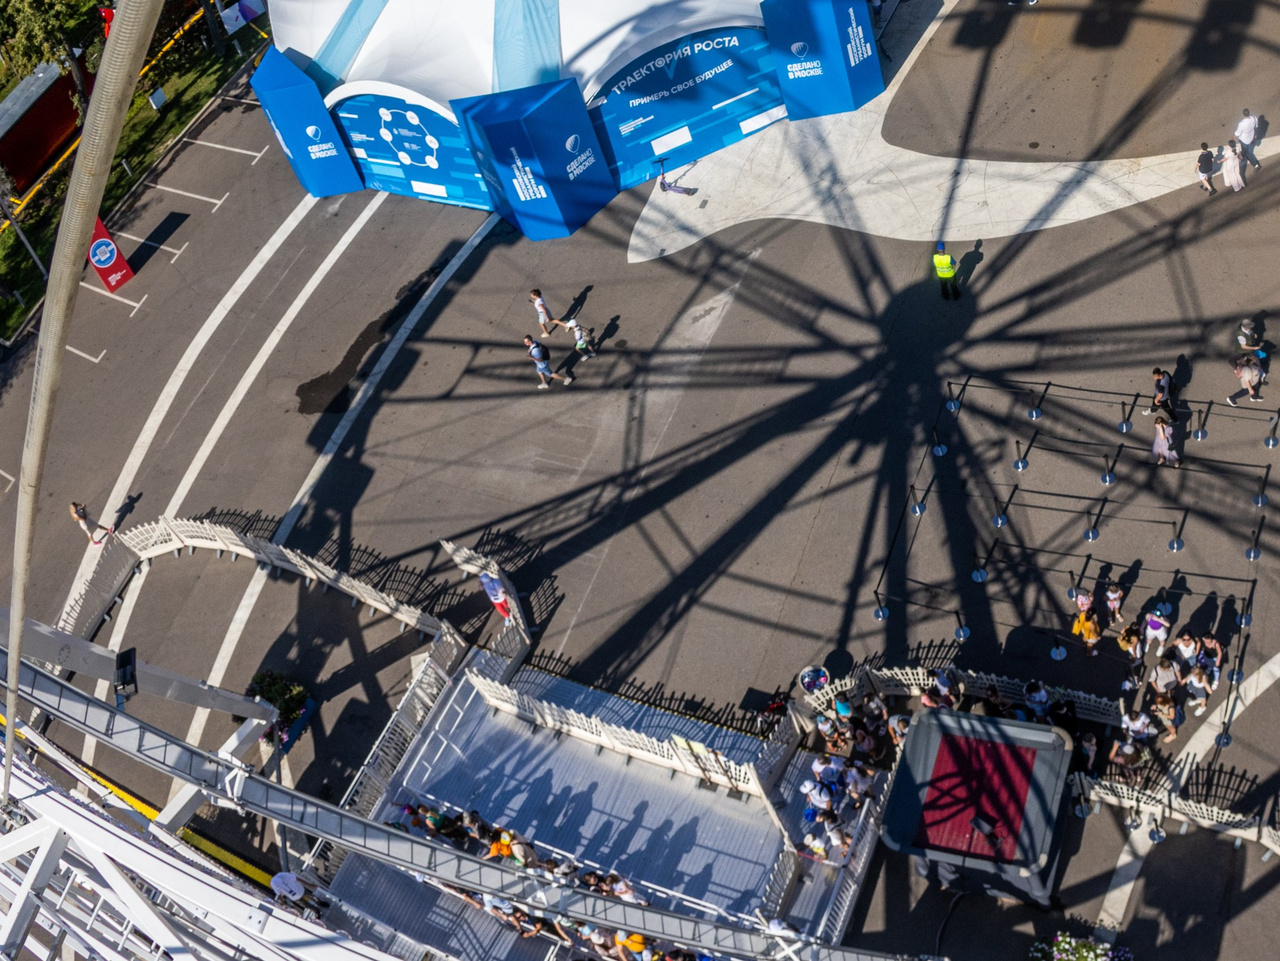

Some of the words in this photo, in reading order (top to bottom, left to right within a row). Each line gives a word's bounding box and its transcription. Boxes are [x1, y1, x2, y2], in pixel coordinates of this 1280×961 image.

[611, 46, 692, 95] ТРАЕКТОРИЯ
[694, 36, 739, 54] РОСТА
[787, 60, 821, 72] СДЕЛАНО
[794, 68, 823, 78] МОСКВЕ
[629, 90, 670, 108] ПРИМЕРЬ
[671, 79, 695, 94] СВОЕ
[696, 59, 734, 84] БУДУЩЕЕ
[308, 142, 334, 152] СДЕЛАНО
[316, 148, 338, 158] МОСКВЕ
[566, 148, 592, 172] СДЕЛАНО
[573, 154, 596, 177] МОСКВЕ
